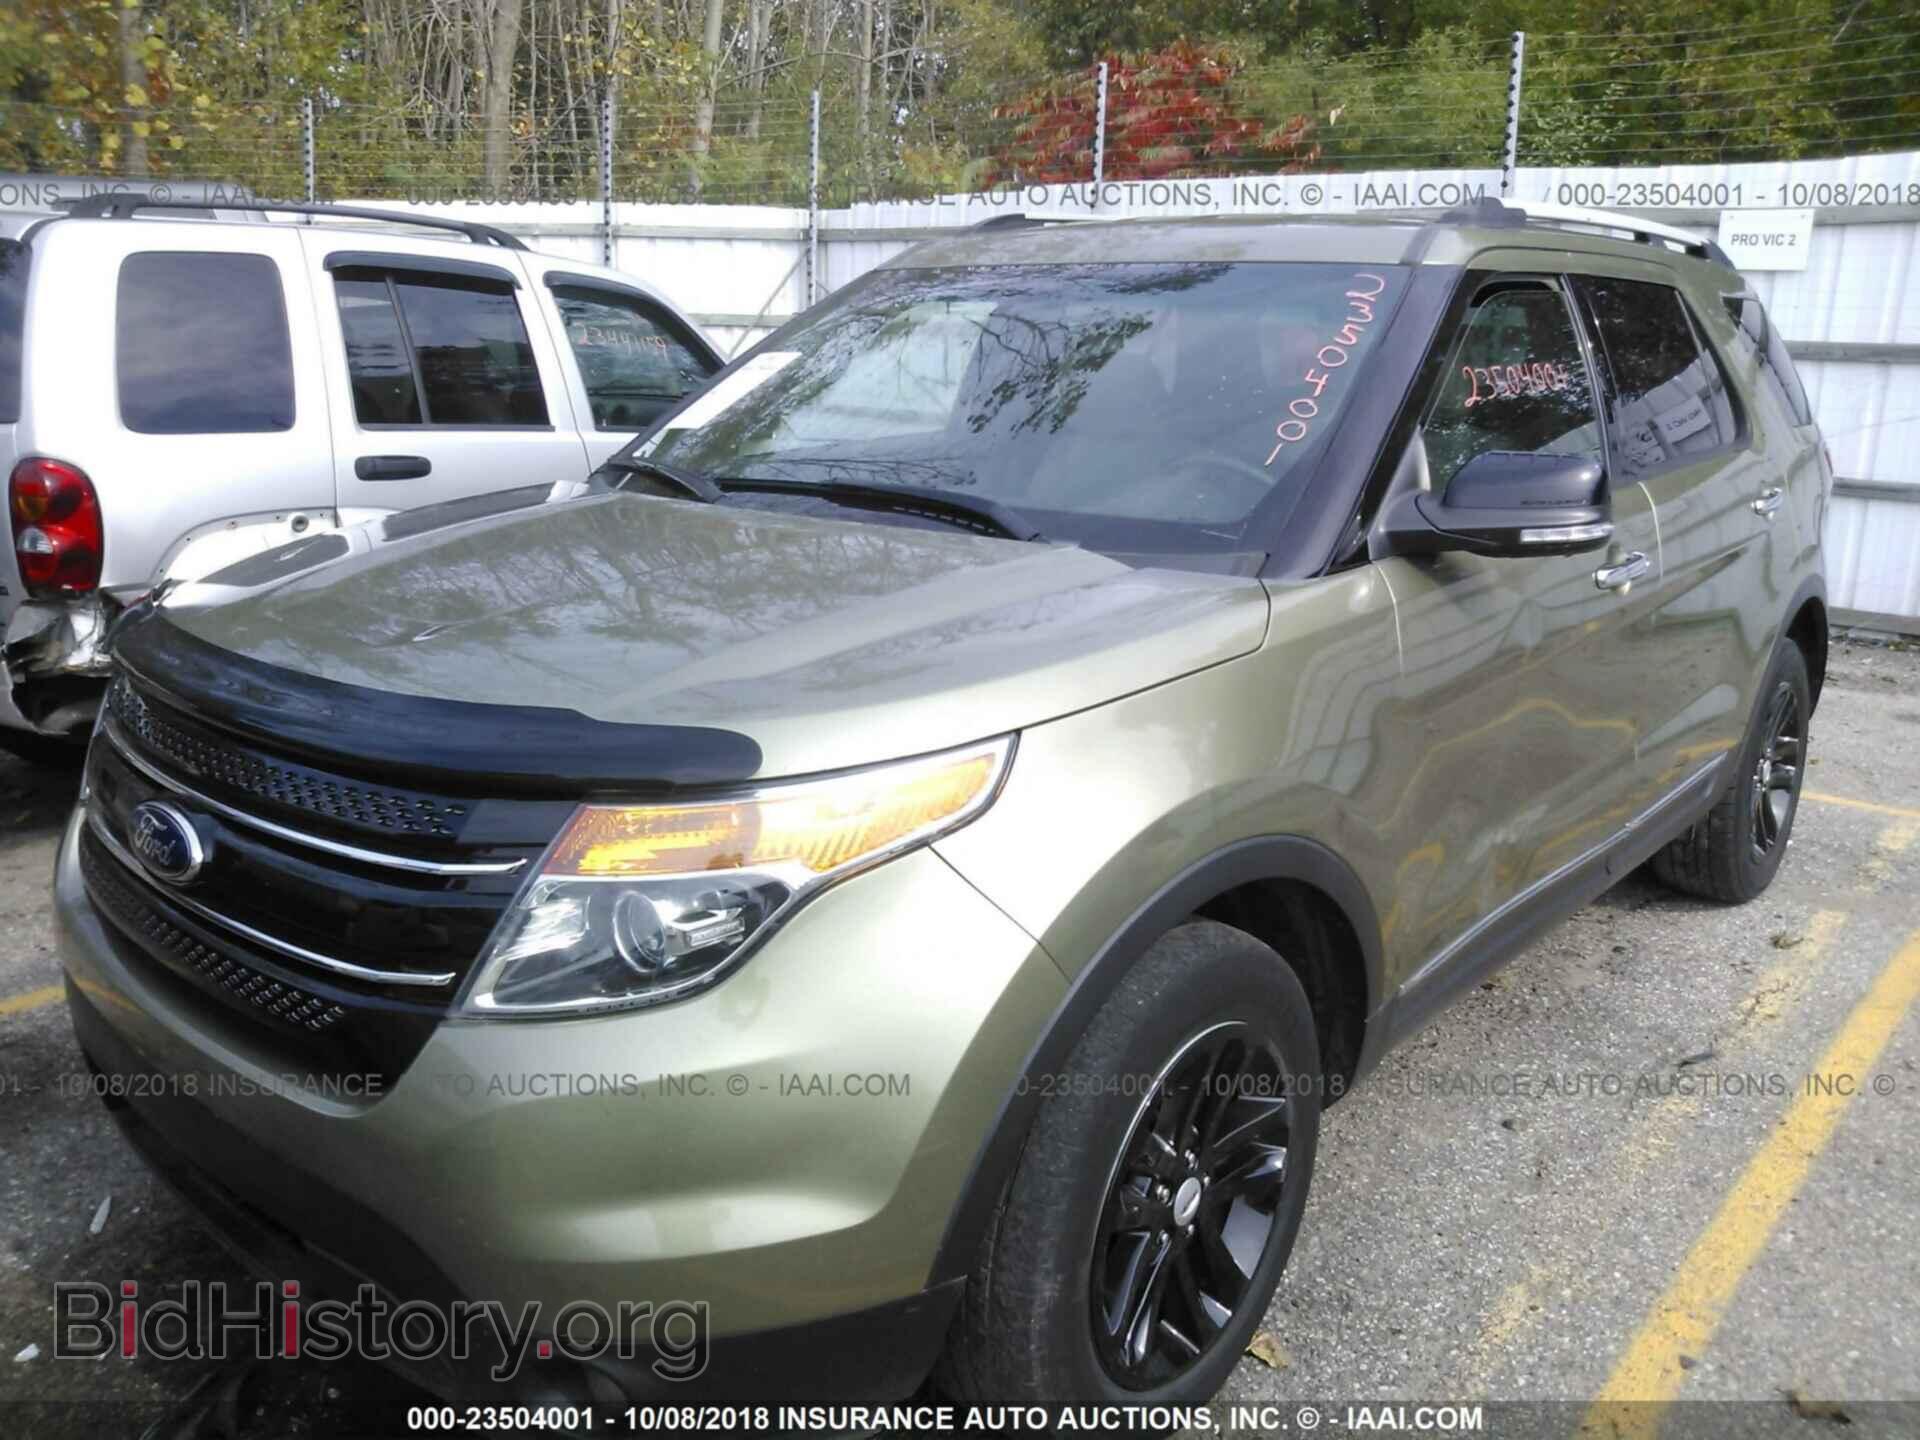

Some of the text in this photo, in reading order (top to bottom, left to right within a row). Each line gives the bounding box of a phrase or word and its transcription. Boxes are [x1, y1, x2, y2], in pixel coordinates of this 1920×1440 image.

[1731, 233, 1797, 247] PRO VIC 2
[134, 811, 178, 866] Ford
